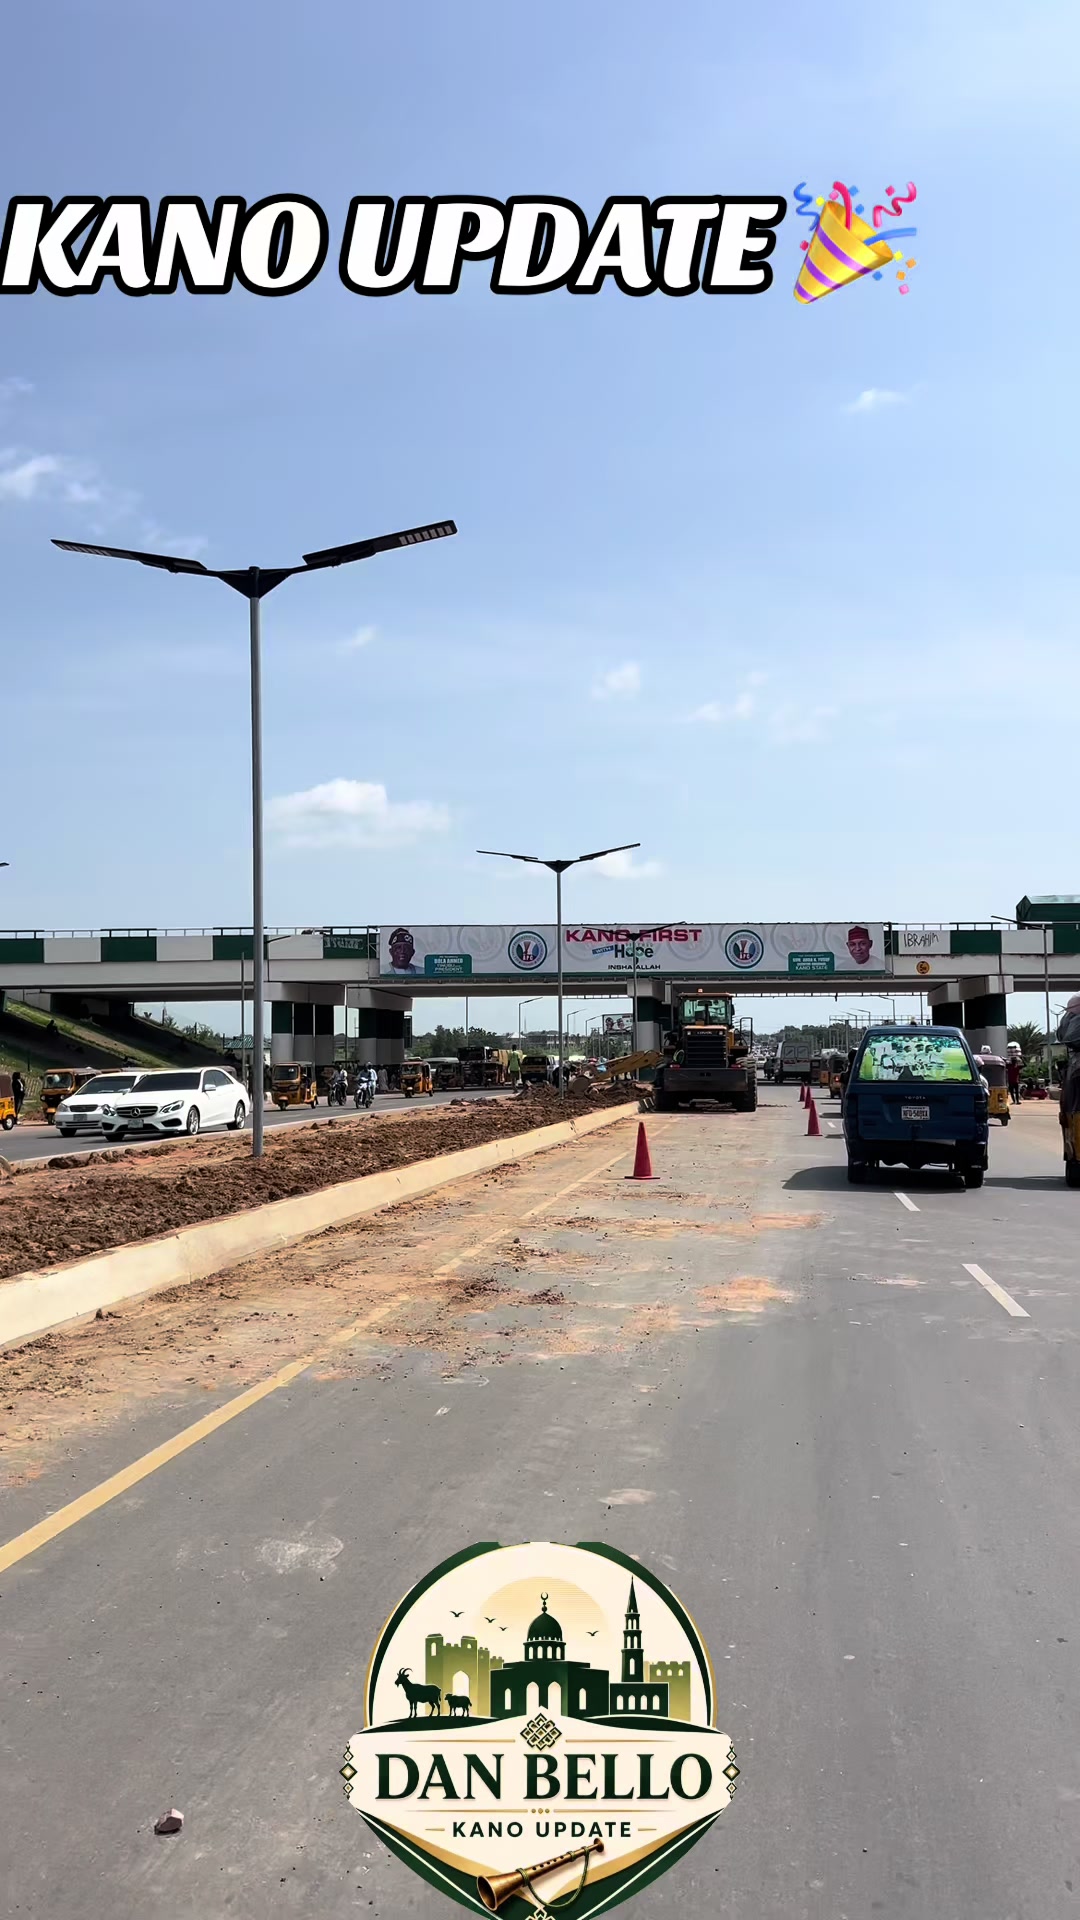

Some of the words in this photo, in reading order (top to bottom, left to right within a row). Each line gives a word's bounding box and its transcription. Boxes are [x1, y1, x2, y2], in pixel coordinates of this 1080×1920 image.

[566, 929, 631, 942] KANO
[639, 929, 702, 942] FIRST
[595, 946, 612, 955] WITH
